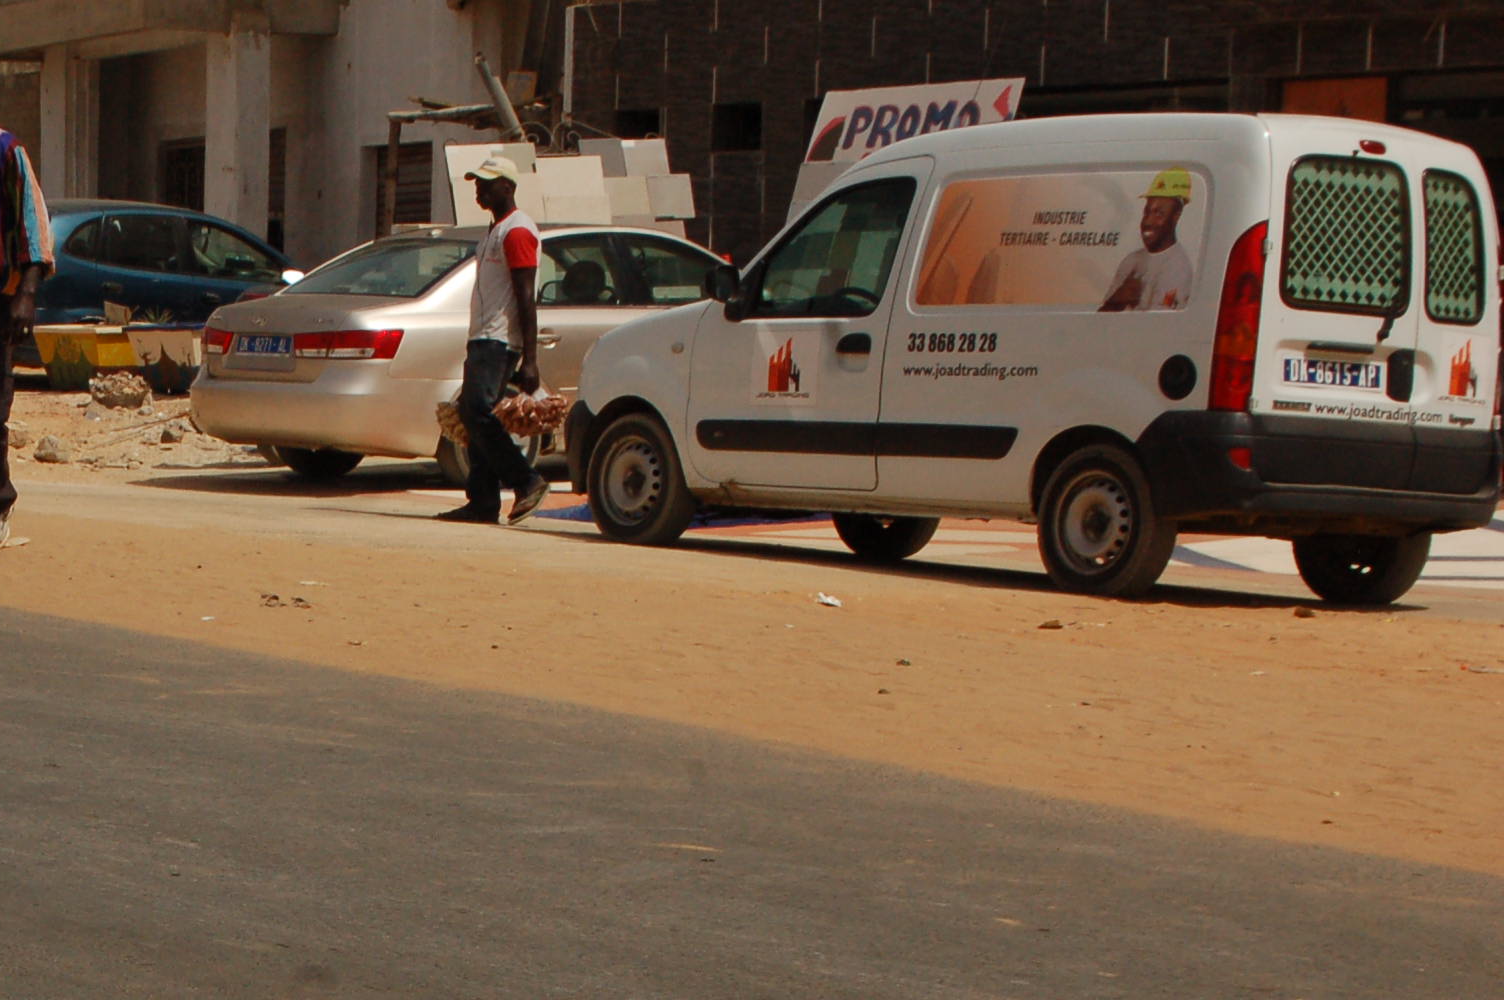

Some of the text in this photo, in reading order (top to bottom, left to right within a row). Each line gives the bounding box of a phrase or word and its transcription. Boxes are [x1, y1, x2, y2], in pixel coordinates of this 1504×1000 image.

[842, 100, 981, 150] PROMO
[1032, 211, 1088, 225] INDUSTRIE
[999, 232, 1050, 247] TERTIAIRE
[1059, 232, 1120, 247] CARRELAGE
[907, 333, 998, 352] 33 868 28 28
[903, 363, 1039, 381] www.joadtrading.com
[1314, 401, 1443, 424] www.joadtrading.com
